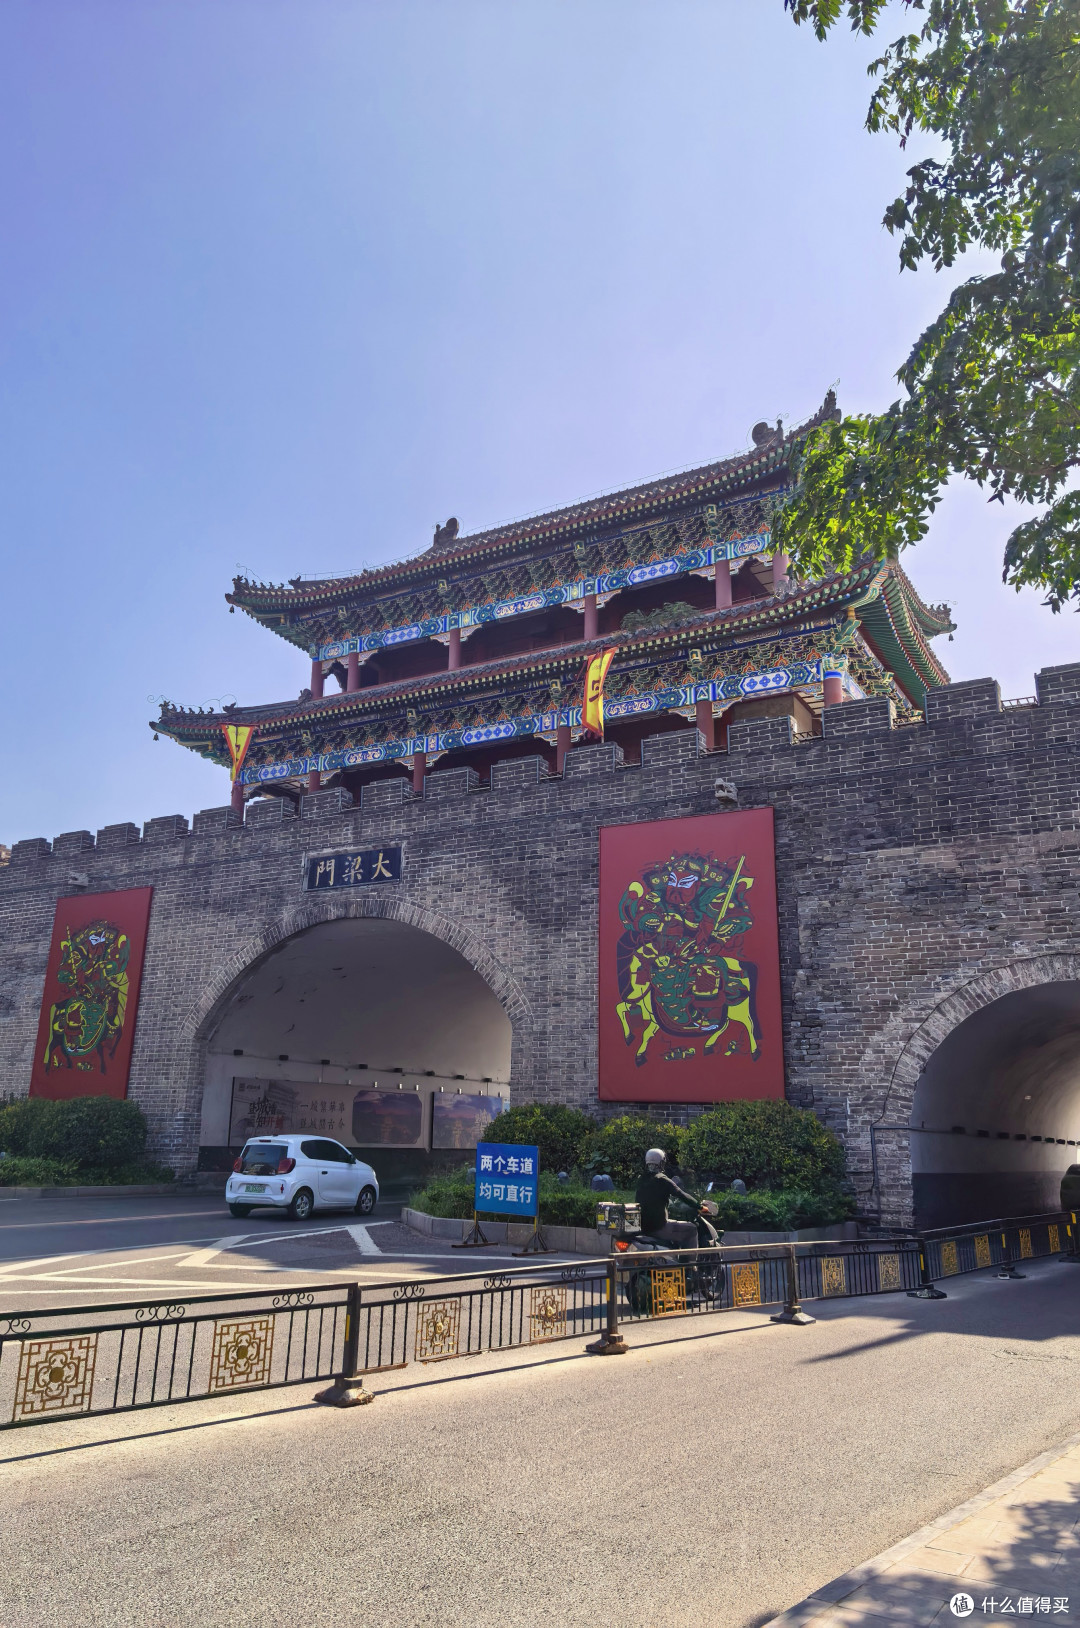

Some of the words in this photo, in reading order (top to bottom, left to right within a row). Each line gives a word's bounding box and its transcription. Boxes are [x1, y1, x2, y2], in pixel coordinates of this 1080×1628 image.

[480, 1154, 534, 1175] 两个车道
[479, 1182, 533, 1204] 均可直行
